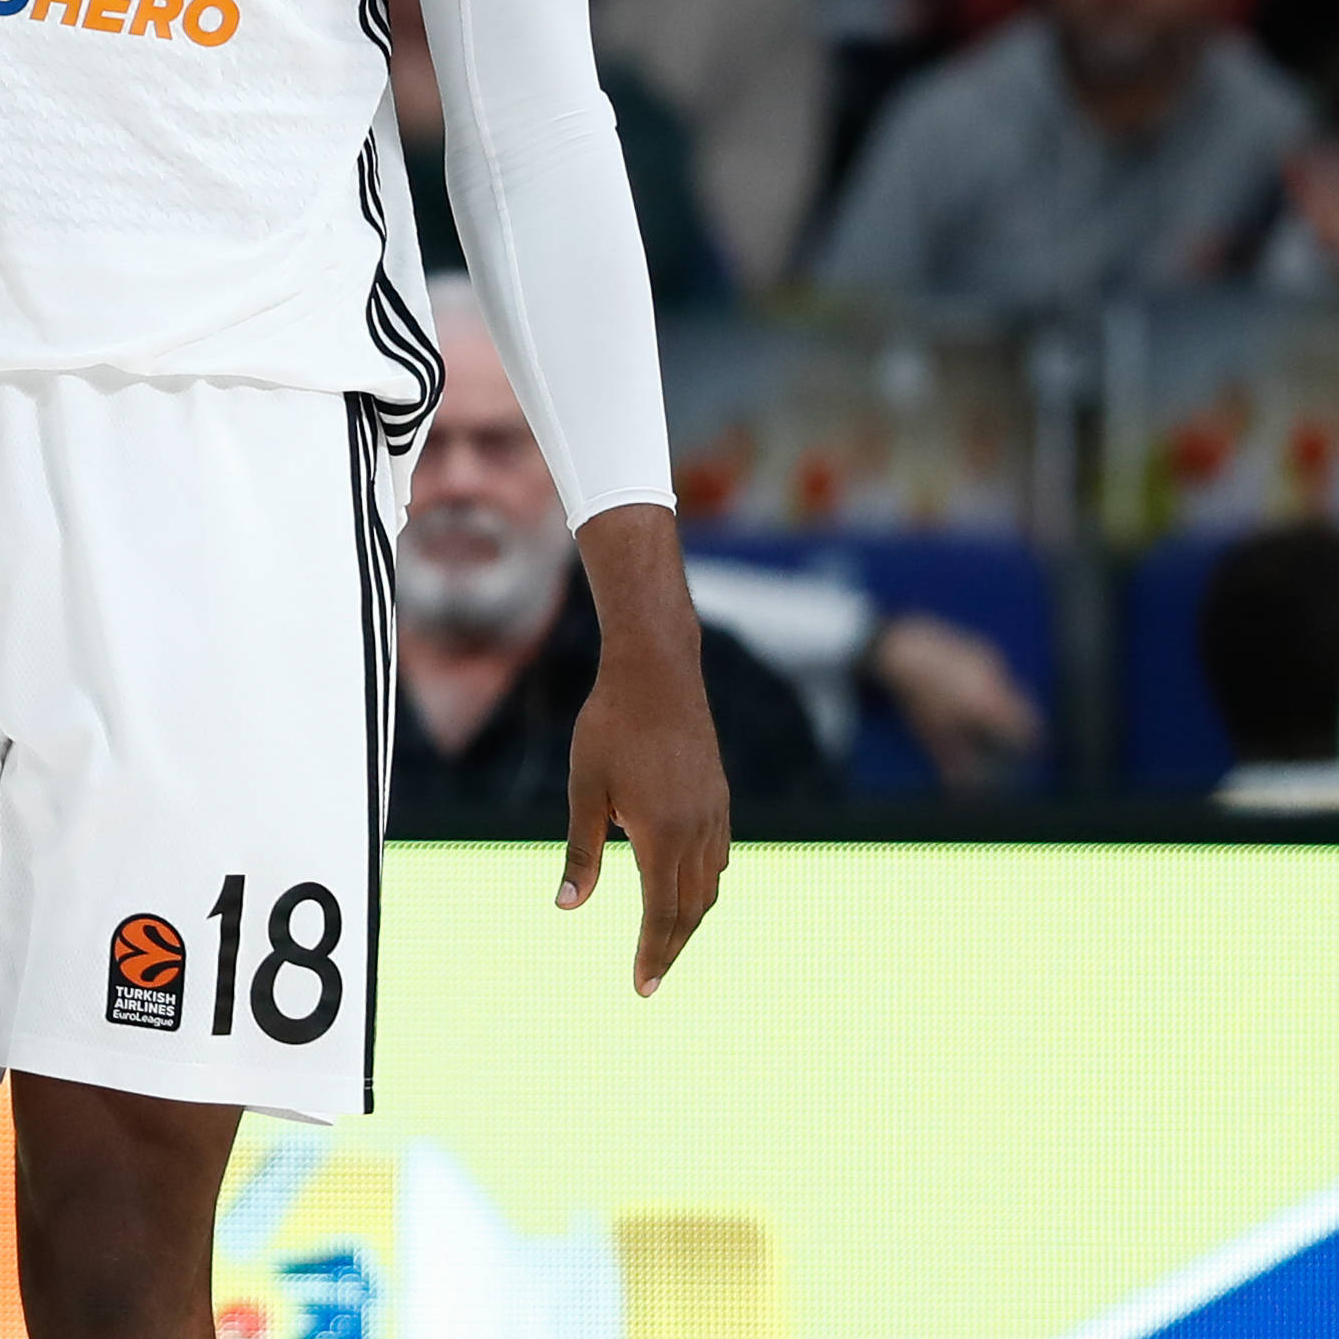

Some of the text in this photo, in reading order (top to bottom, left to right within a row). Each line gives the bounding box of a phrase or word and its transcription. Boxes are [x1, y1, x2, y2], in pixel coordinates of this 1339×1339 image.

[207, 874, 344, 1046] 18
[115, 985, 176, 1005] TURKISH
[114, 998, 175, 1016] AIRLINES
[112, 1009, 174, 1027] EuroLeague
